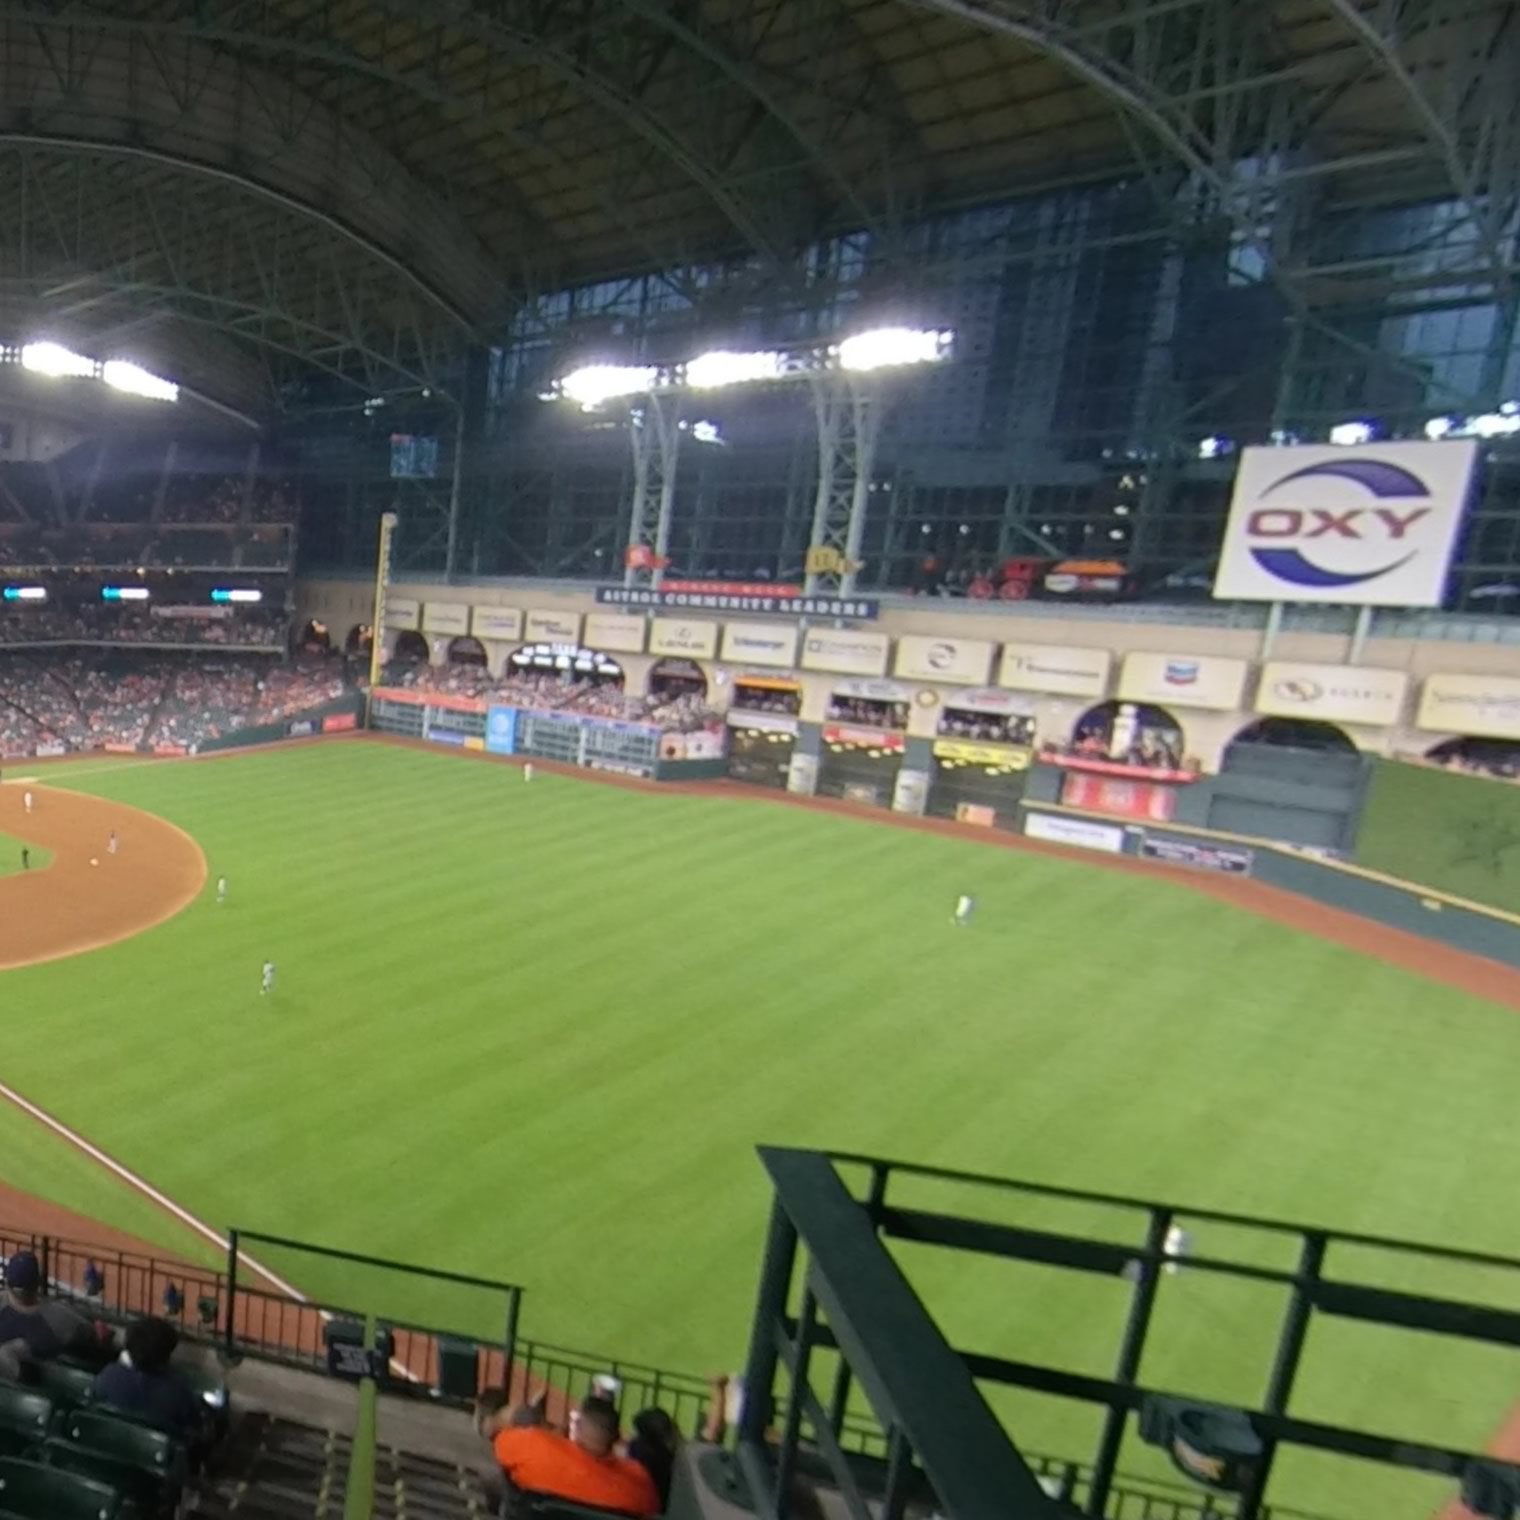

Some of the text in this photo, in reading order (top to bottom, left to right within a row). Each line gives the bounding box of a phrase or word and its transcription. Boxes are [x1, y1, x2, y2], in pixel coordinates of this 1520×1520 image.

[1247, 506, 1432, 540] OXY
[603, 589, 868, 617] ASTROS COMMUNITY LEADERS
